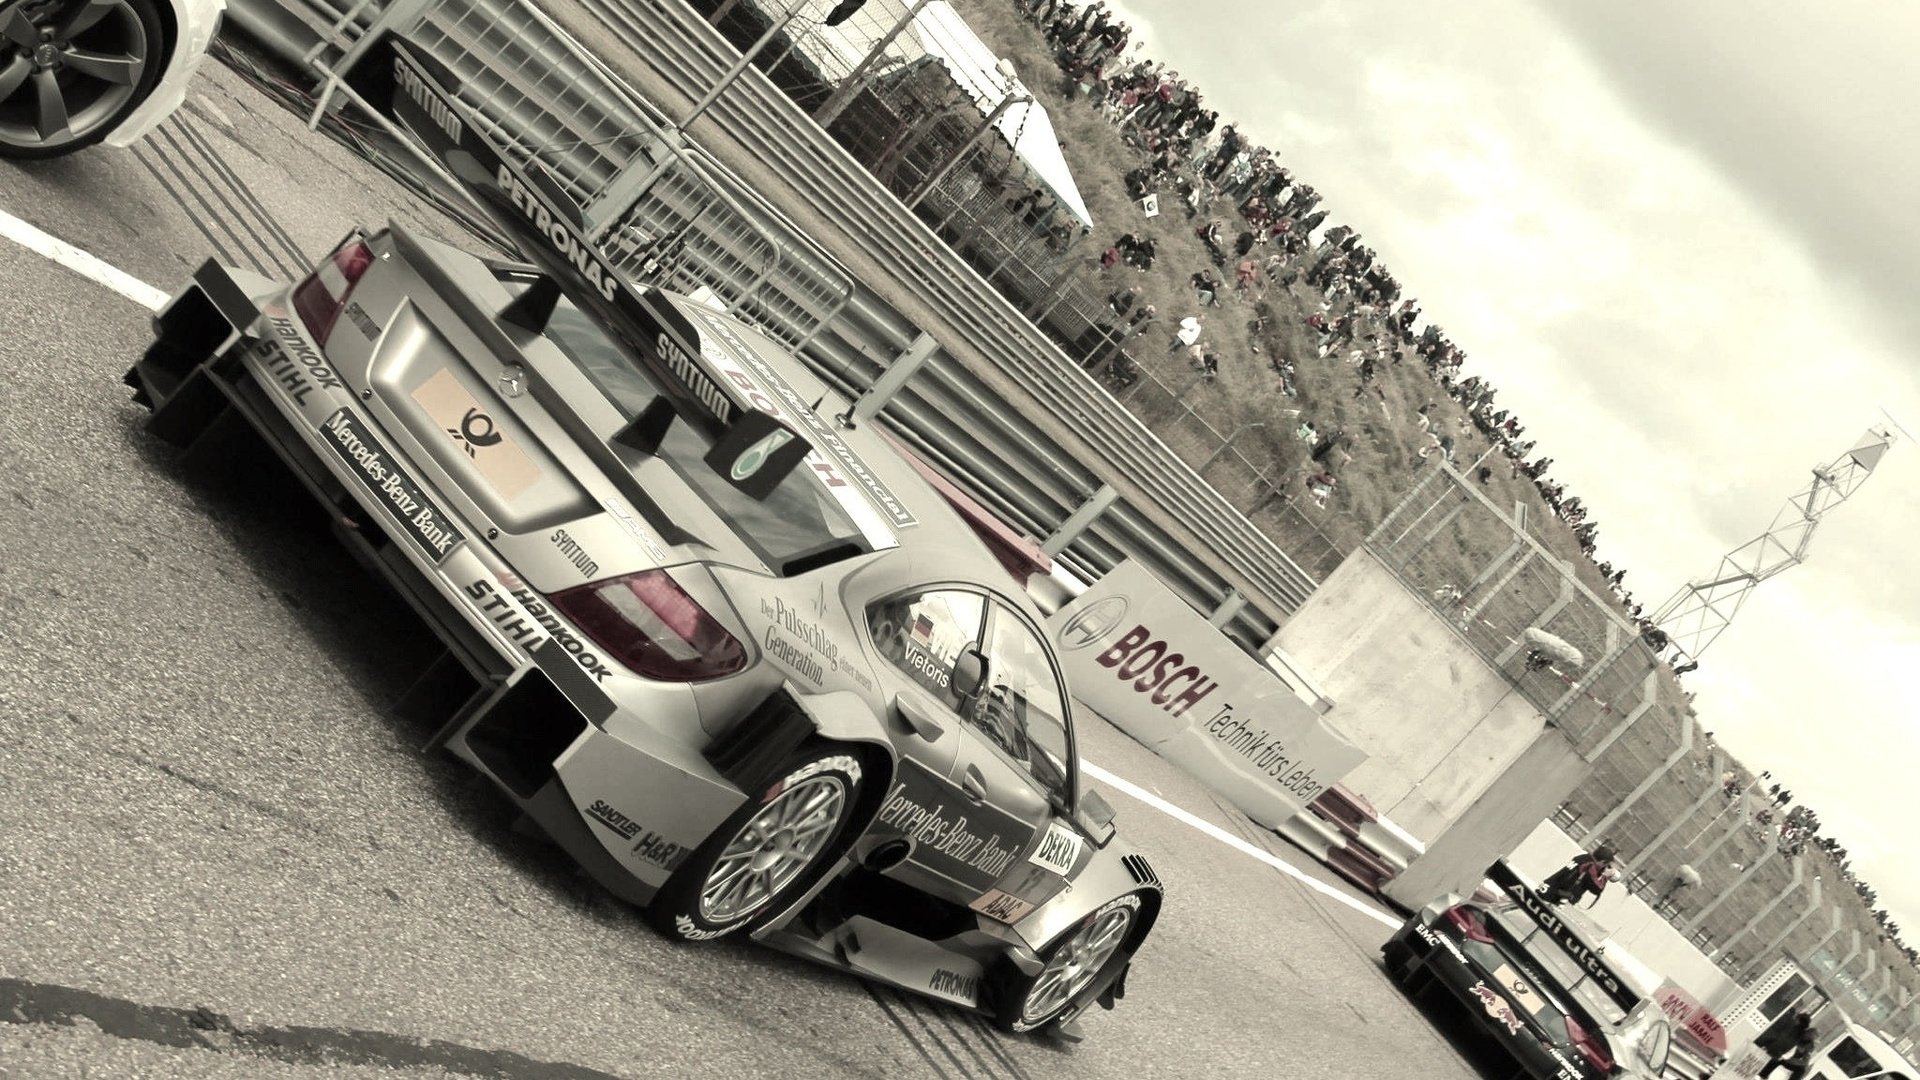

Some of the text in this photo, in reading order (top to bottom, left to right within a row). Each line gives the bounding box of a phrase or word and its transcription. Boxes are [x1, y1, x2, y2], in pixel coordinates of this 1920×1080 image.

[394, 57, 461, 146] SYNTIUM
[498, 163, 617, 302] PETRONAS
[258, 340, 313, 407] STIHL
[657, 332, 731, 427] SYNTIUM
[703, 314, 909, 522] Mercedes-Benz Financial
[725, 369, 848, 488] BOH
[326, 410, 419, 516] Mercedes-Benz
[411, 506, 453, 555] Bank
[550, 529, 600, 579] SYNTIUM
[465, 579, 544, 655] STIHL
[774, 596, 838, 672] Pulsschlag
[764, 624, 823, 687] Generation.
[904, 641, 949, 688] Vietoris
[1095, 624, 1218, 718] BOSCH
[1203, 703, 1323, 801] Technik fürs Leben
[590, 799, 641, 837] SANDTLER
[631, 832, 678, 866] H&R
[968, 834, 1019, 878] Bank
[1038, 828, 1075, 870] DEKRA
[981, 892, 1022, 921] ADAC
[1508, 884, 1619, 993] Audi ultra
[1700, 1013, 1720, 1031] RALF
